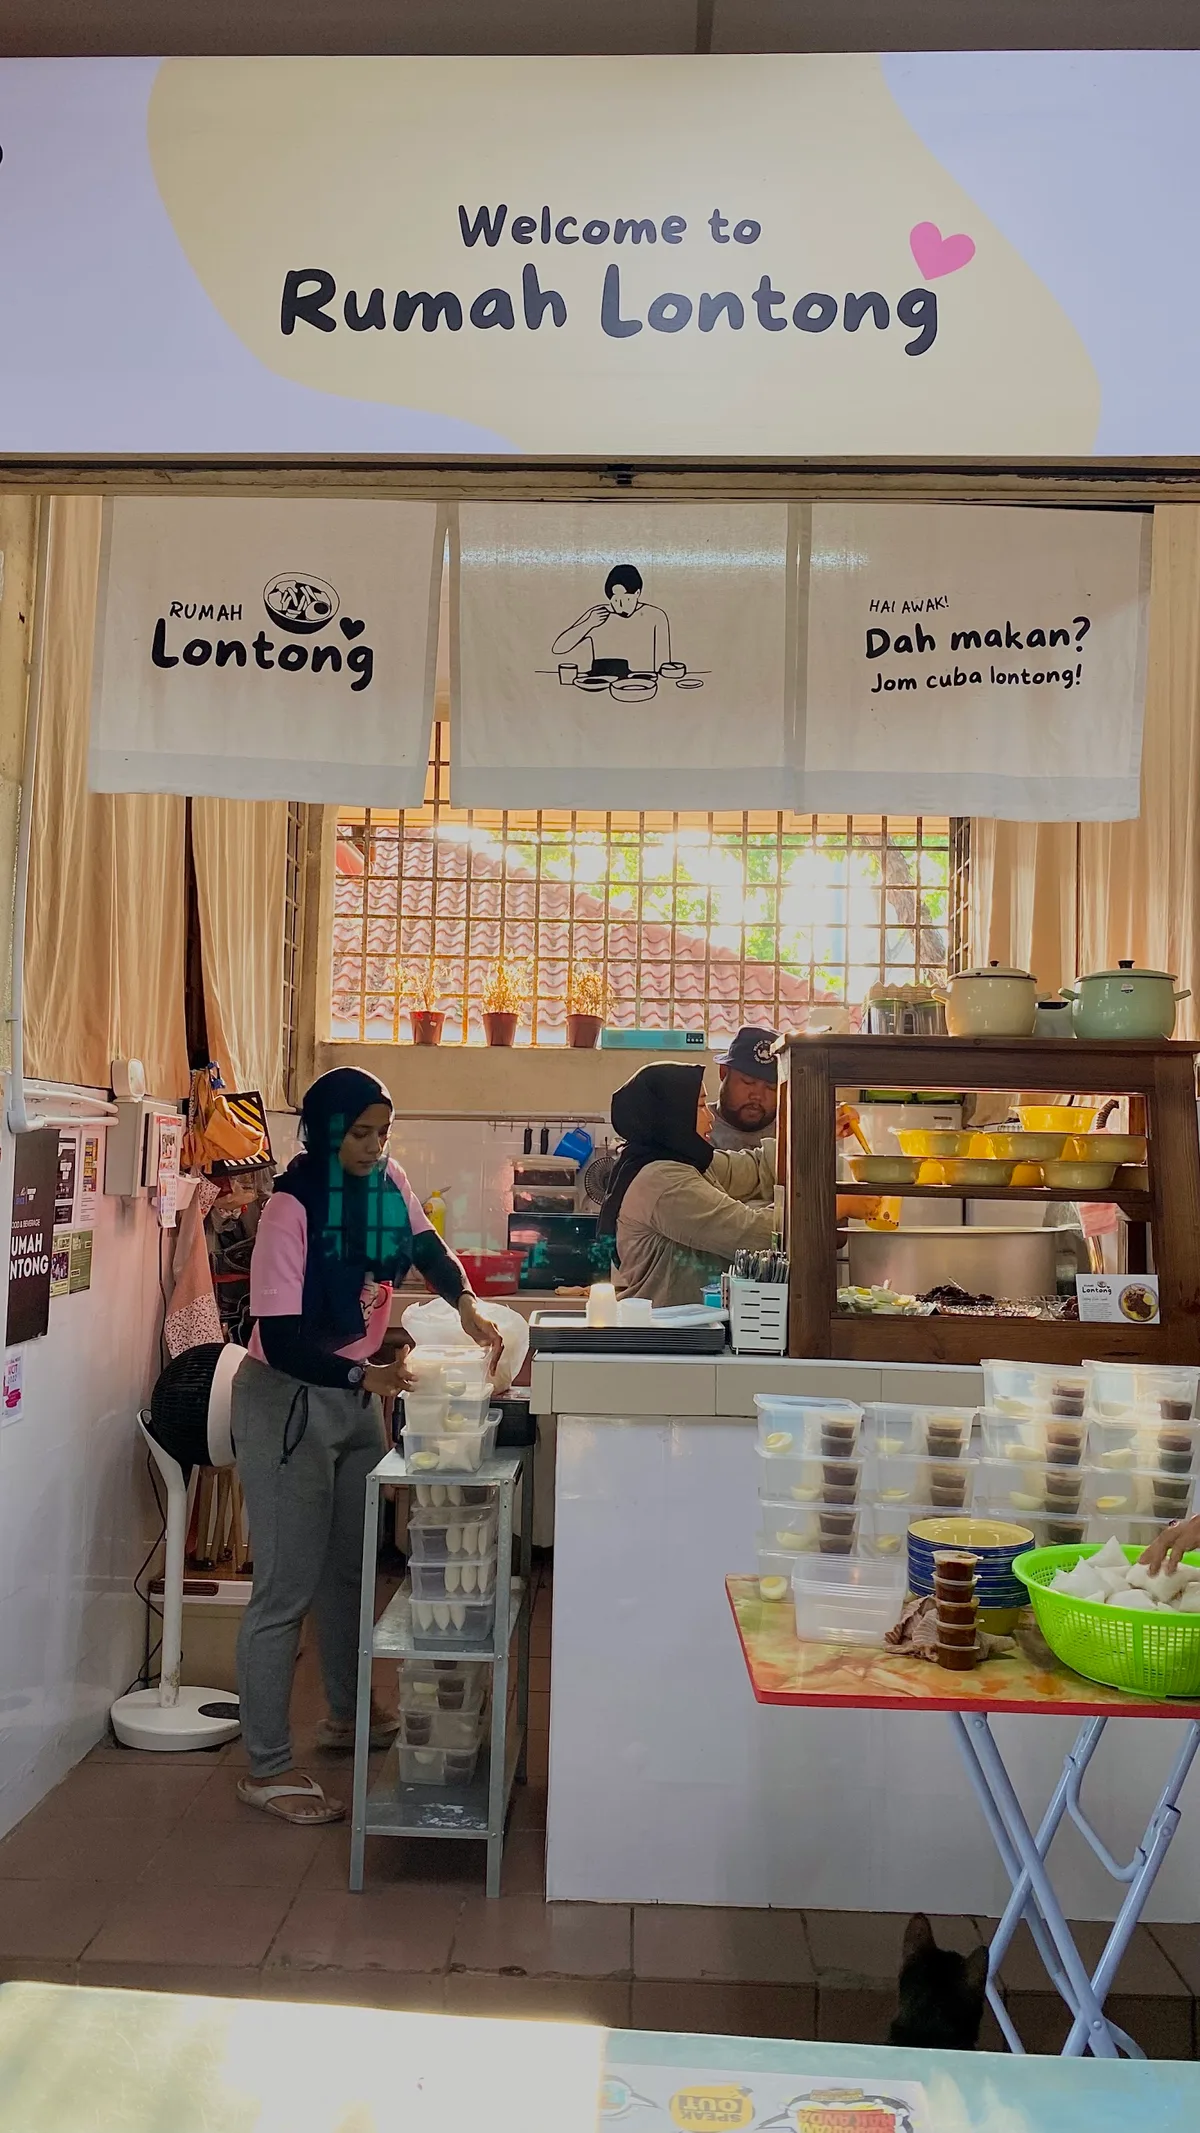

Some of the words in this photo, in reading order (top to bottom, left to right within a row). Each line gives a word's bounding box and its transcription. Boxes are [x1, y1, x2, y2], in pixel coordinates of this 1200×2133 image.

[459, 204, 687, 248] Welcome
[708, 208, 762, 245] to
[281, 263, 568, 335] Rumah
[601, 264, 938, 357] Lontong
[169, 601, 243, 621] RUMAH
[869, 599, 896, 614] HAI
[901, 595, 950, 614] AWAK!
[866, 623, 936, 659] Dah
[951, 616, 1091, 653] makan?
[152, 617, 374, 692] Lontong
[871, 673, 917, 693] Jom
[926, 666, 982, 689] cuba
[990, 664, 1082, 690] lontong!
[11, 1232, 43, 1257] UMAH
[10, 1254, 49, 1281] NTONG
[1082, 1286, 1112, 1296] Lontong
[681, 2113, 742, 2123] SPEAK
[683, 2099, 738, 2113] OUT
